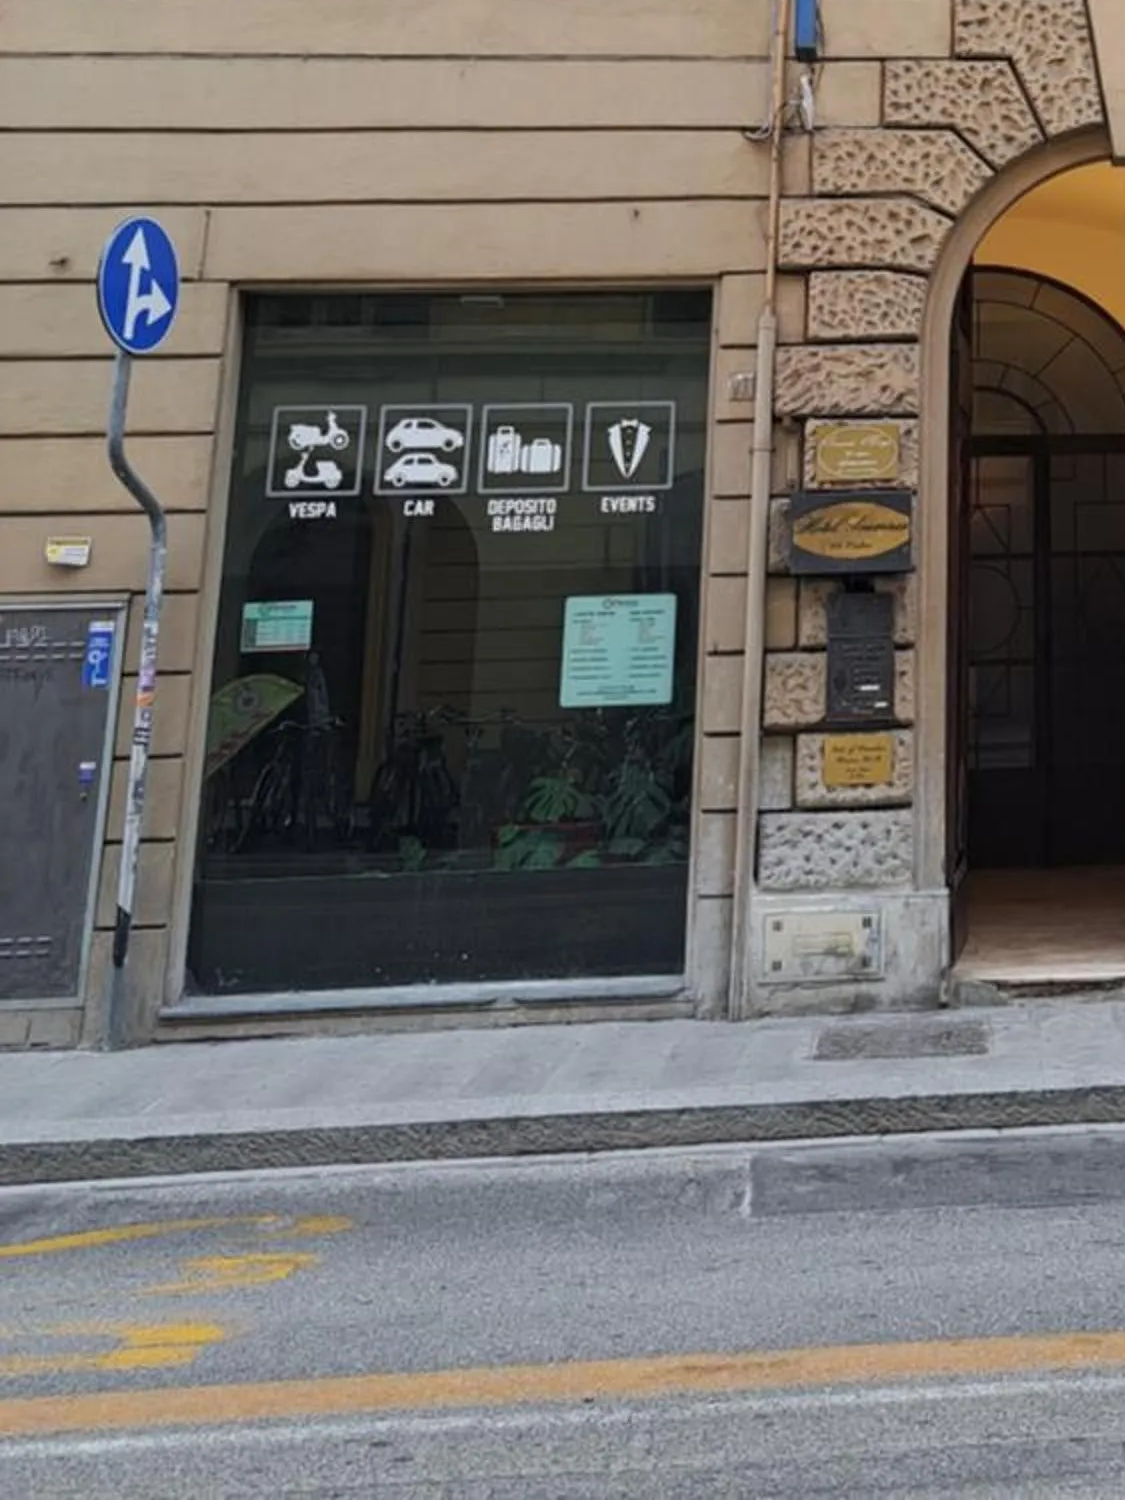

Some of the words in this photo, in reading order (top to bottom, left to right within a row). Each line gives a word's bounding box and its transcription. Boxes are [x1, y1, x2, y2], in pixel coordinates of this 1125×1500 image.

[288, 501, 337, 519] VESPA
[403, 499, 435, 517] CAR
[487, 498, 557, 515] DEPOSITO
[600, 495, 656, 513] EVENTS
[492, 515, 555, 533] BAGAGLI
